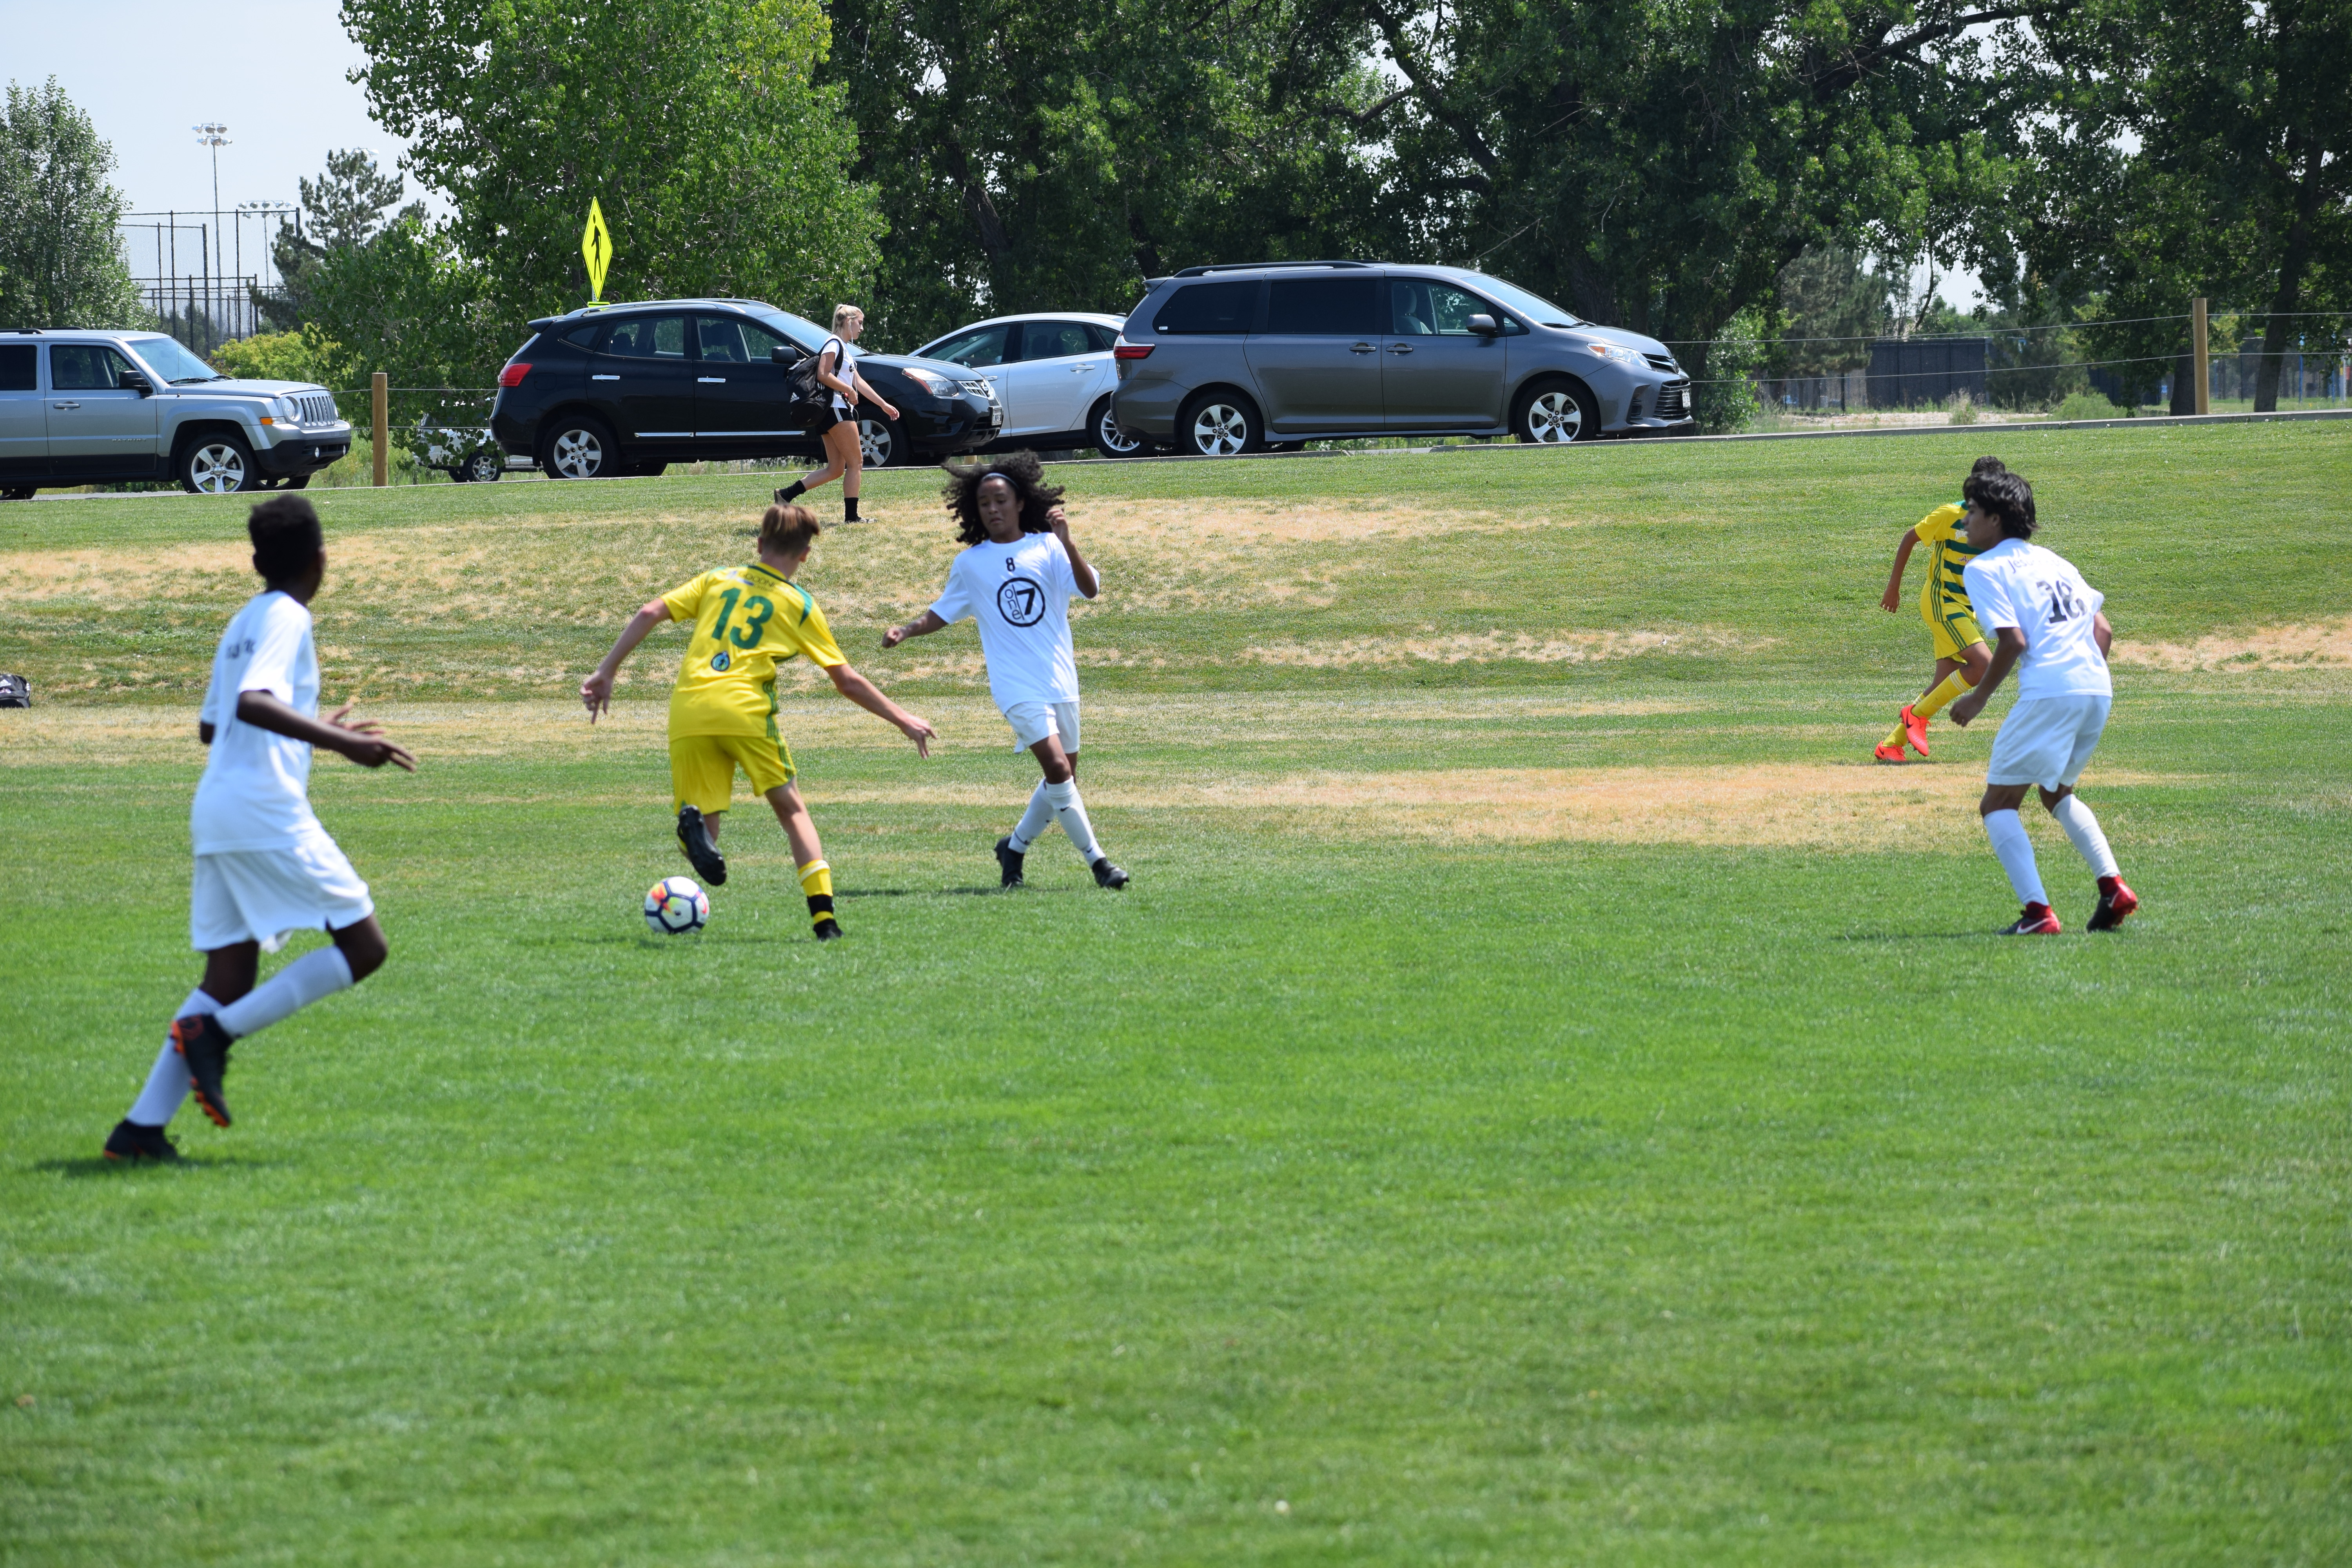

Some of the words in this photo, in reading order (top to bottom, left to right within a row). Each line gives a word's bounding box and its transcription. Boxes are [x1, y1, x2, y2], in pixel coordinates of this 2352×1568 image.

[1006, 557, 1016, 572] 8
[711, 587, 774, 650] 13
[1005, 589, 1022, 620] one
[1016, 588, 1035, 615] 7
[2036, 580, 2088, 624] 18
